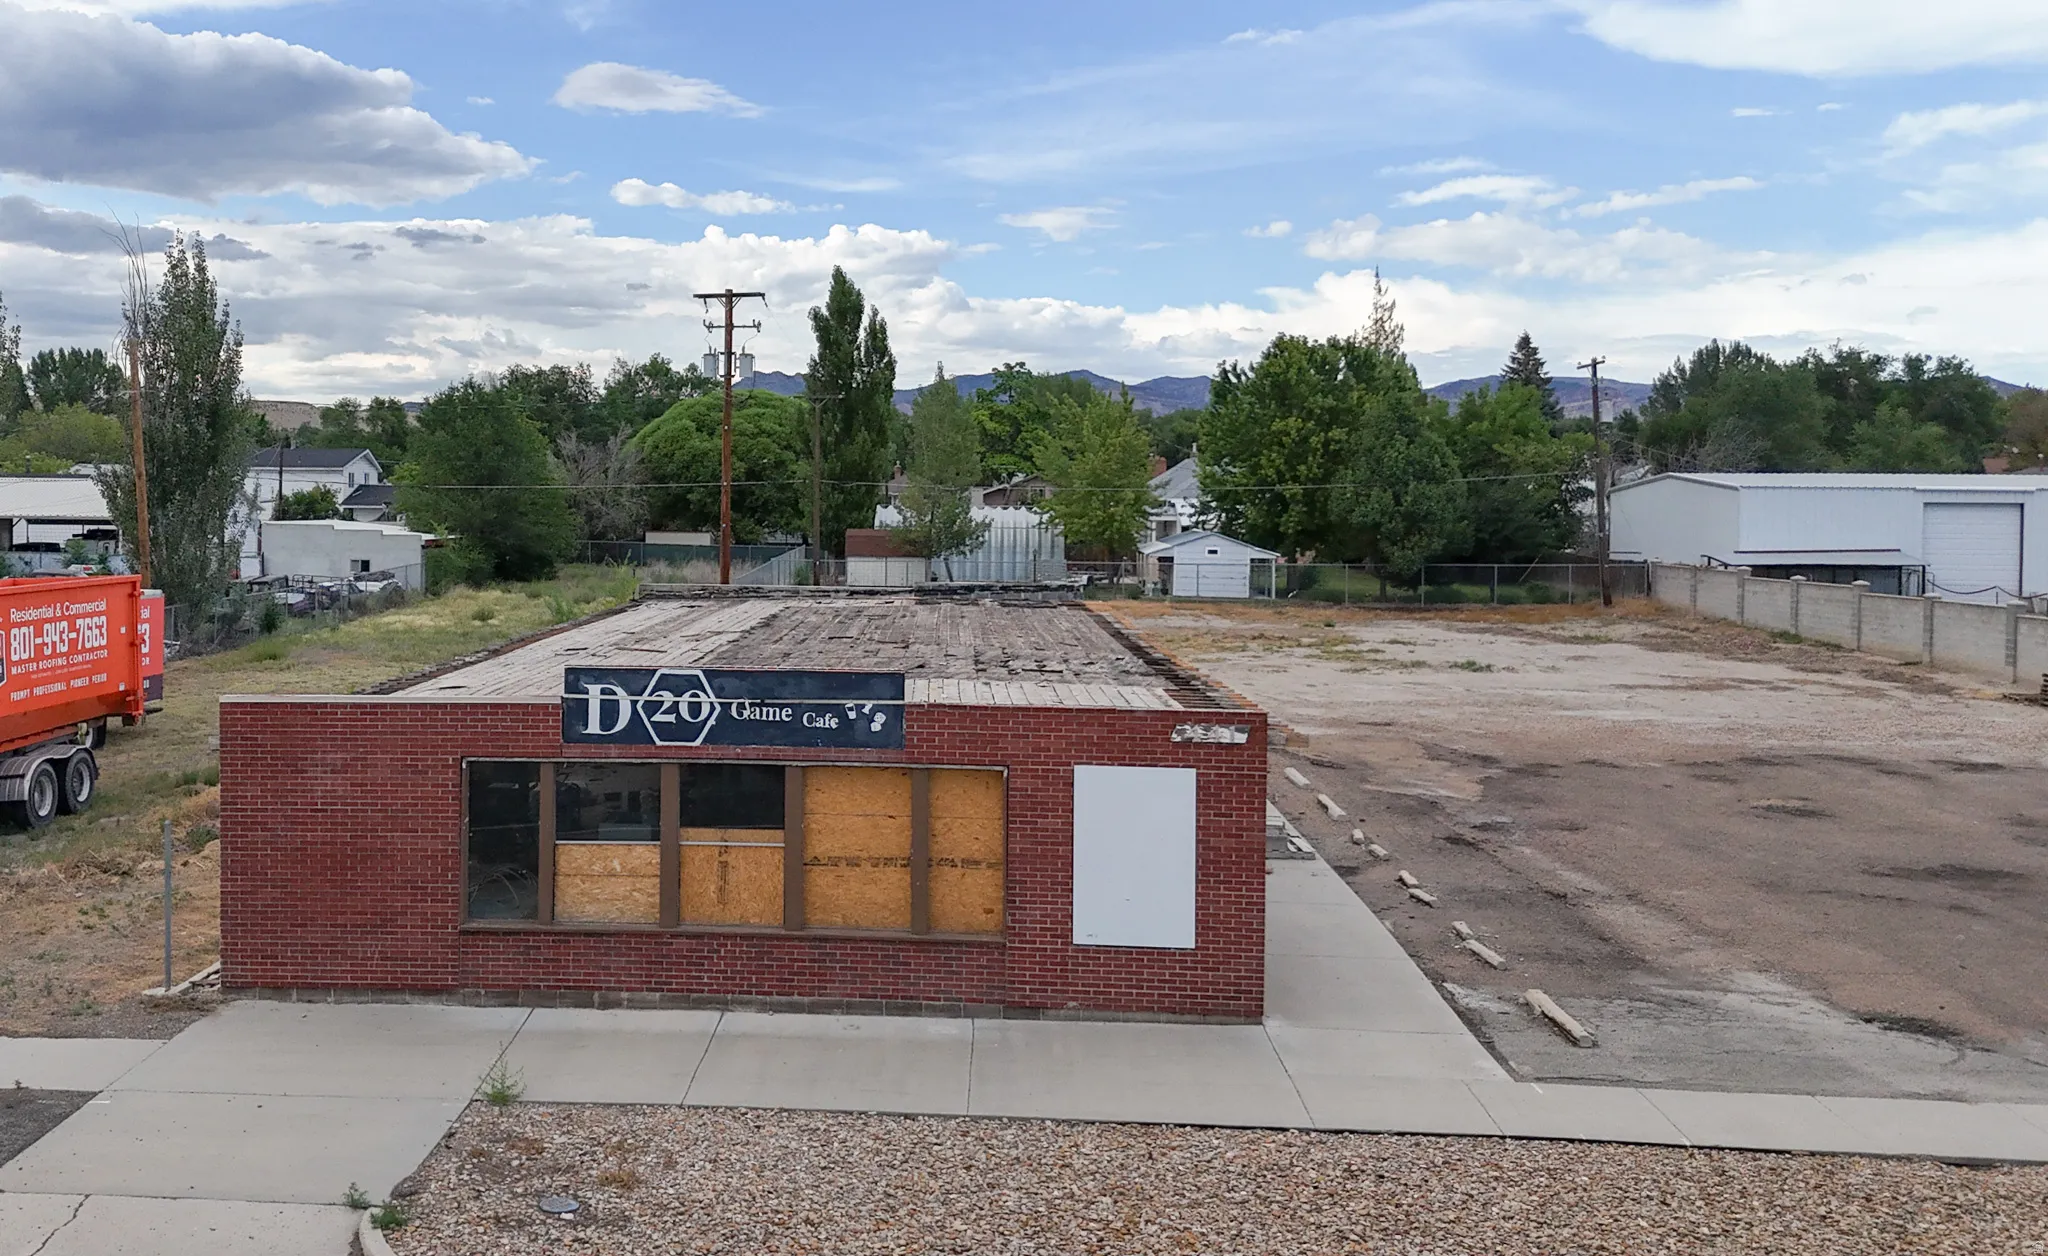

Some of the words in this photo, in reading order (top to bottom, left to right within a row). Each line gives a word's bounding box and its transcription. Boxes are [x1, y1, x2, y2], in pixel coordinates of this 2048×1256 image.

[10, 605, 54, 623] Residential
[55, 603, 62, 617] &
[63, 598, 106, 616] Commercial
[10, 615, 107, 661] 801-943-7663
[11, 662, 37, 675] MASTER
[39, 656, 67, 669] ROOFING
[69, 649, 108, 663] CONTRACTOR
[10, 689, 30, 702] PROMPT
[33, 682, 67, 696] PROFESSIONAL
[731, 698, 793, 722] Game
[802, 711, 840, 730] Cafe
